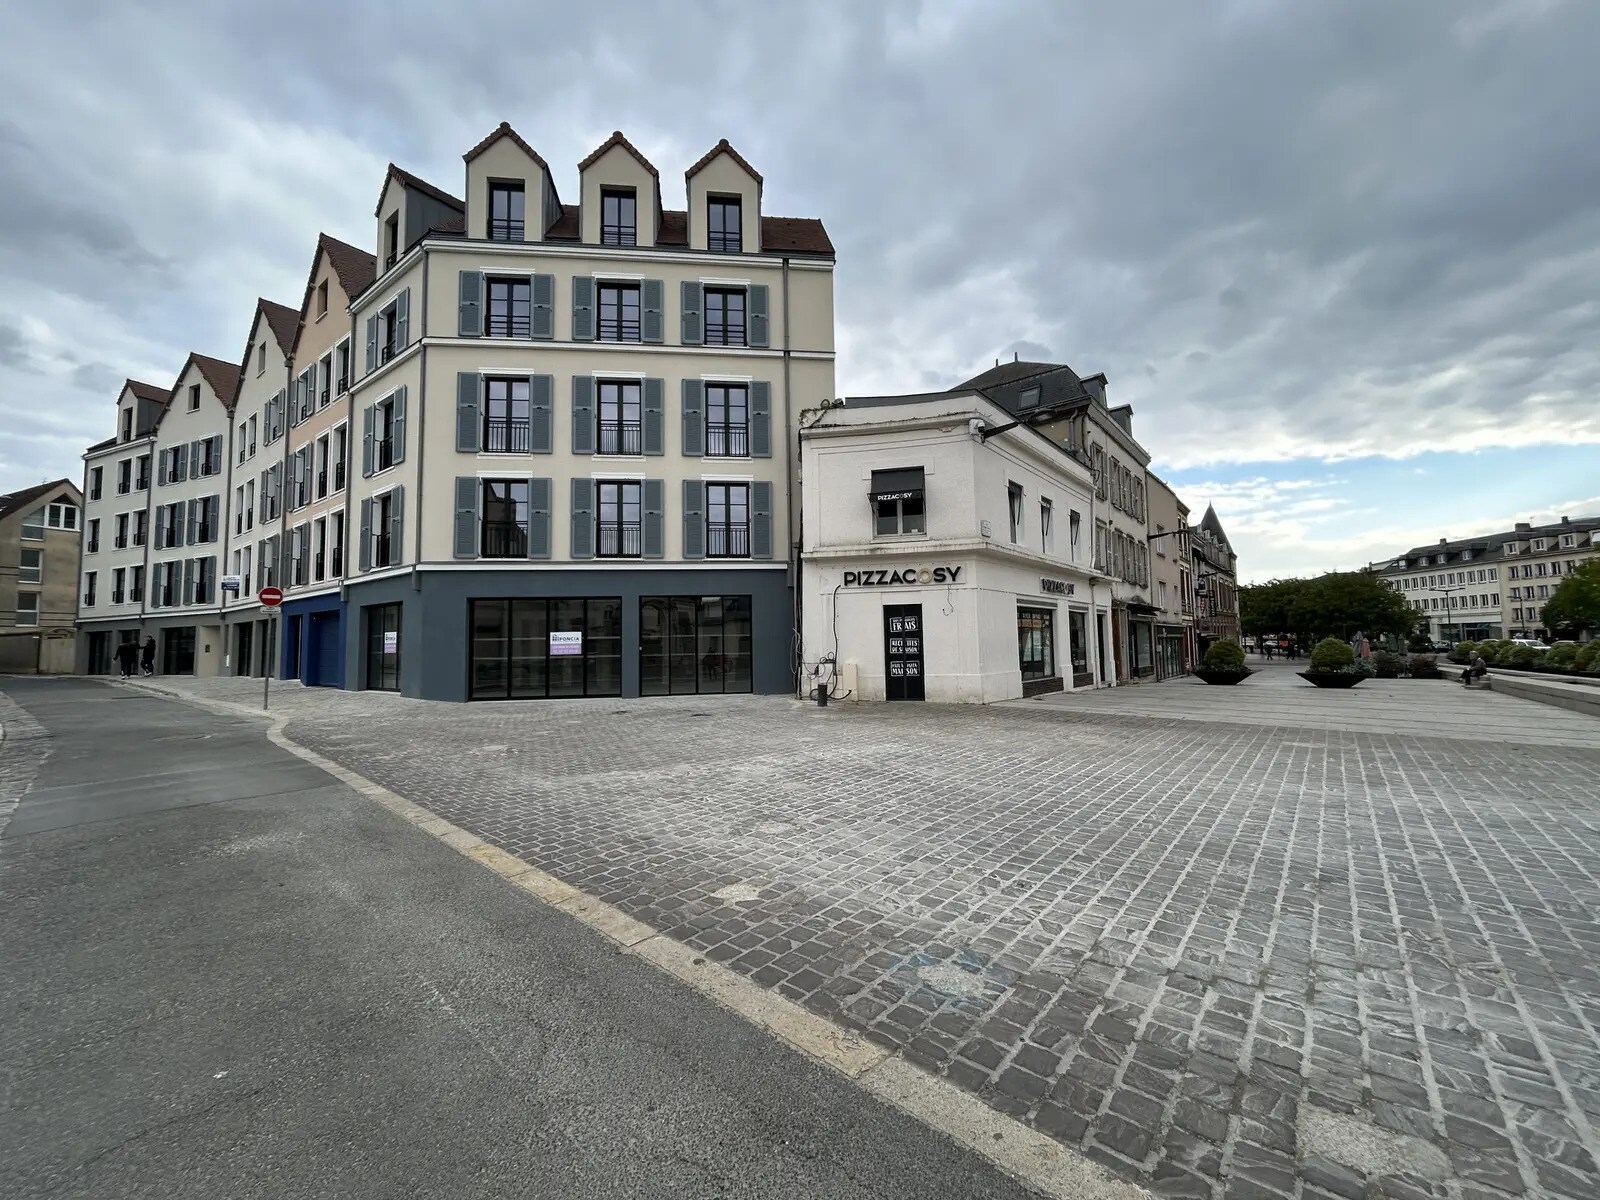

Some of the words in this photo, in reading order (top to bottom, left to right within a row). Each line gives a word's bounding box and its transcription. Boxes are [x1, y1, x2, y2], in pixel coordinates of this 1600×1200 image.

[877, 492, 912, 500] PIZZACOSY
[843, 566, 962, 586] PIZZACOSY
[893, 621, 916, 631] FRAIS
